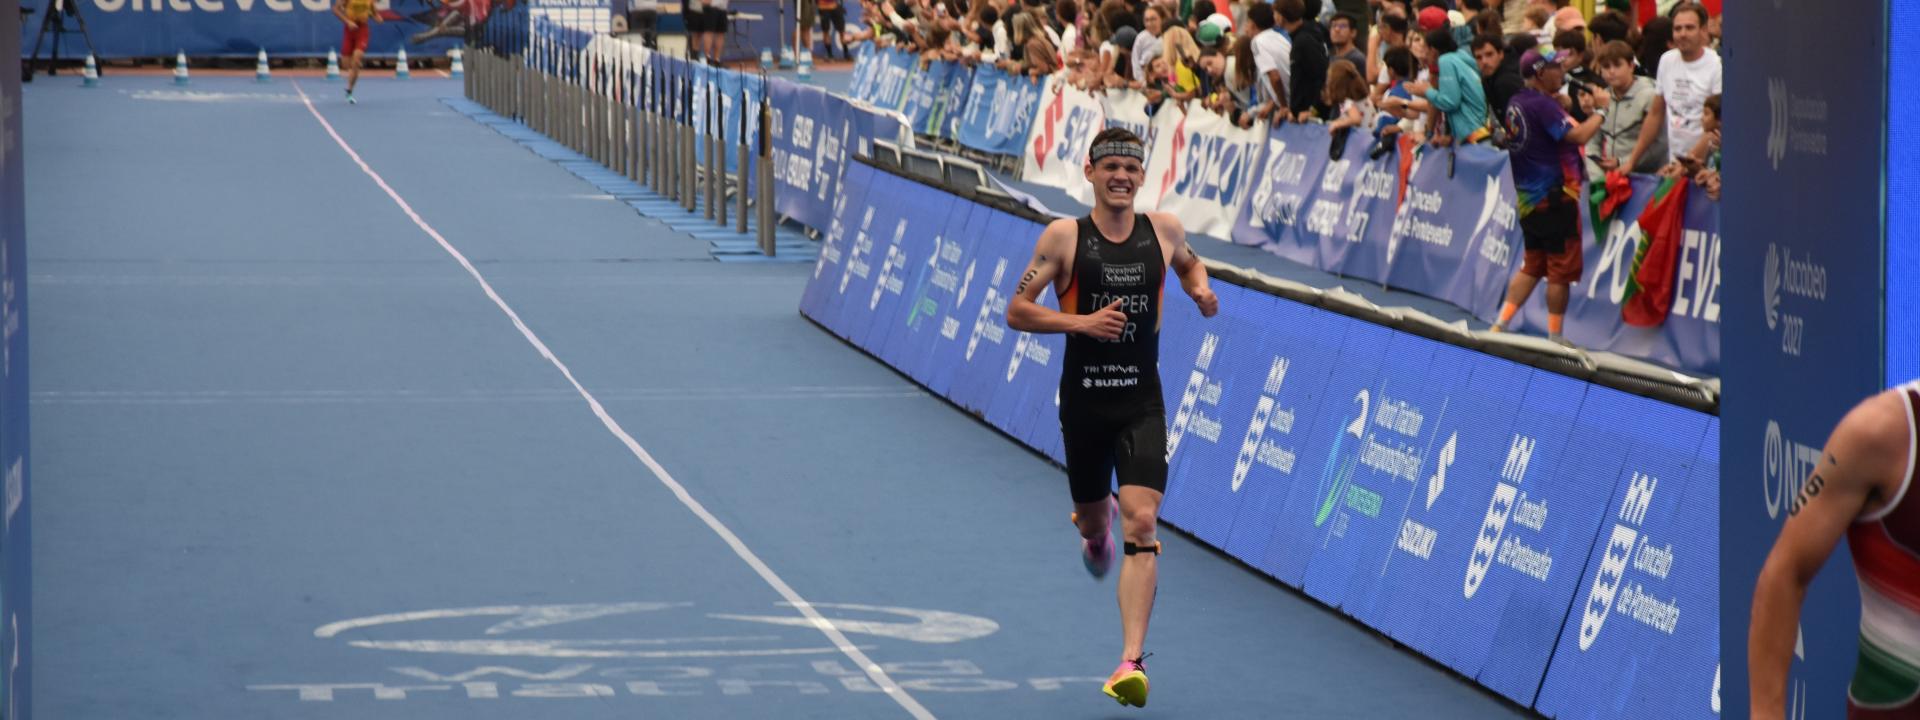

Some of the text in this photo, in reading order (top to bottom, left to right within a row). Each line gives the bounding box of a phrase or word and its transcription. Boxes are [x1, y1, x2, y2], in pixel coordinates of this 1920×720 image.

[1782, 246, 1826, 300] Xacobeo
[1782, 314, 1803, 357] 2027
[1083, 365, 1140, 374] TRI TRAVEL
[1094, 377, 1138, 388] SUZUKI
[1513, 491, 1548, 531] Concello
[1397, 517, 1438, 561] SUZUKI
[1508, 536, 1552, 582] Pontevedra
[1634, 534, 1674, 580] Concello
[1617, 580, 1680, 634] de Pontevedra
[388, 659, 985, 681] World
